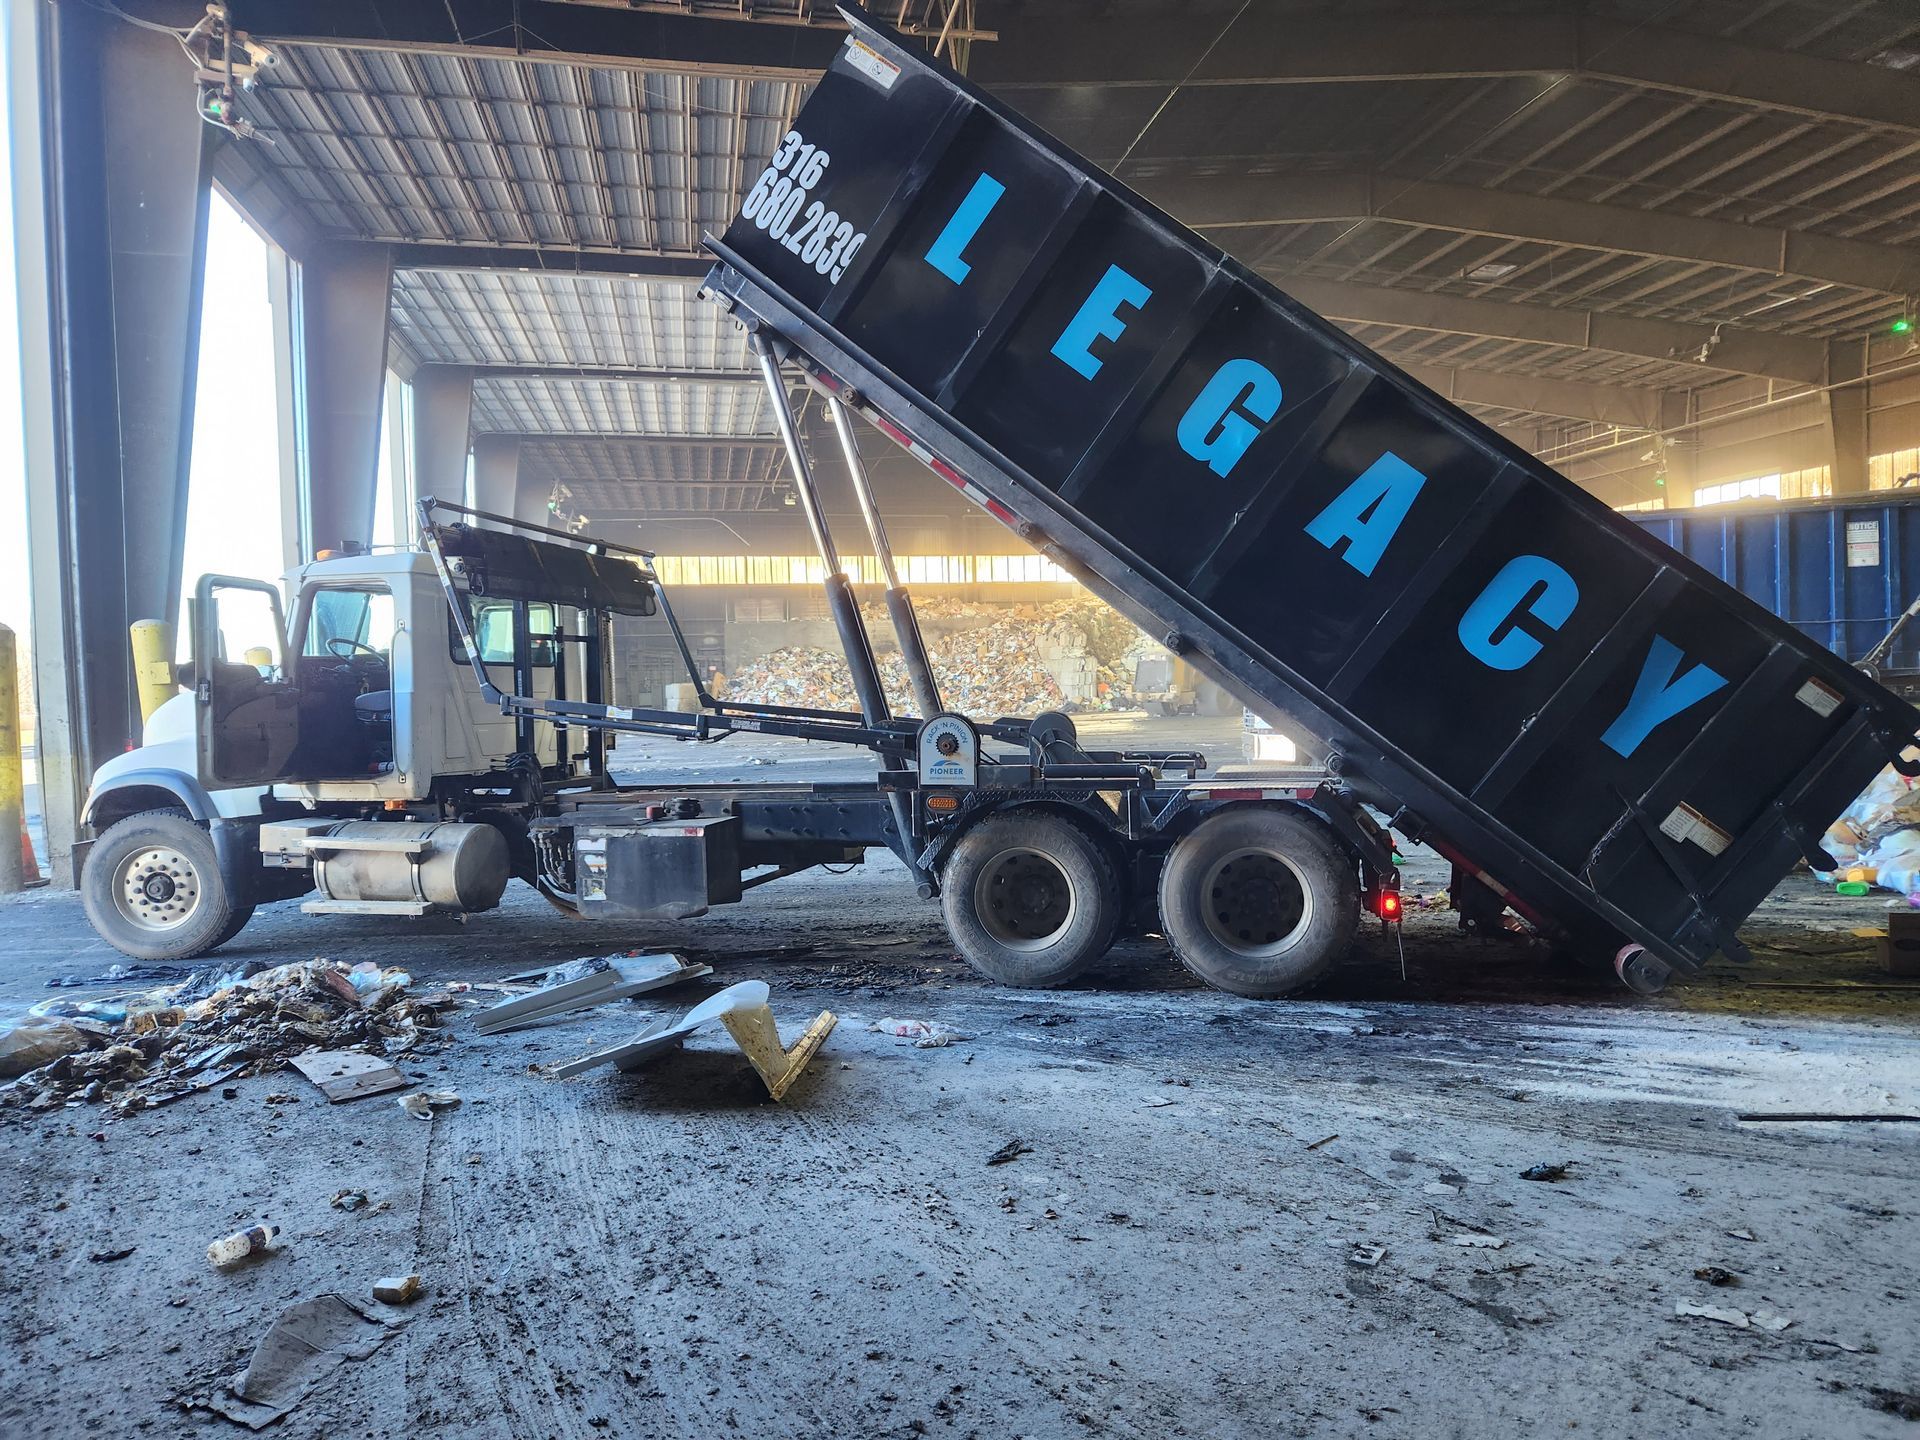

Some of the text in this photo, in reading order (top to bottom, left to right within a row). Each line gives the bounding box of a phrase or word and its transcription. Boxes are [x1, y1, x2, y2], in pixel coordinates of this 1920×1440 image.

[772, 130, 830, 190] 316
[741, 166, 868, 286] 680.2839
[925, 173, 1728, 758] LEGACY
[926, 725, 940, 743] RACK
[949, 722, 969, 744] PINION
